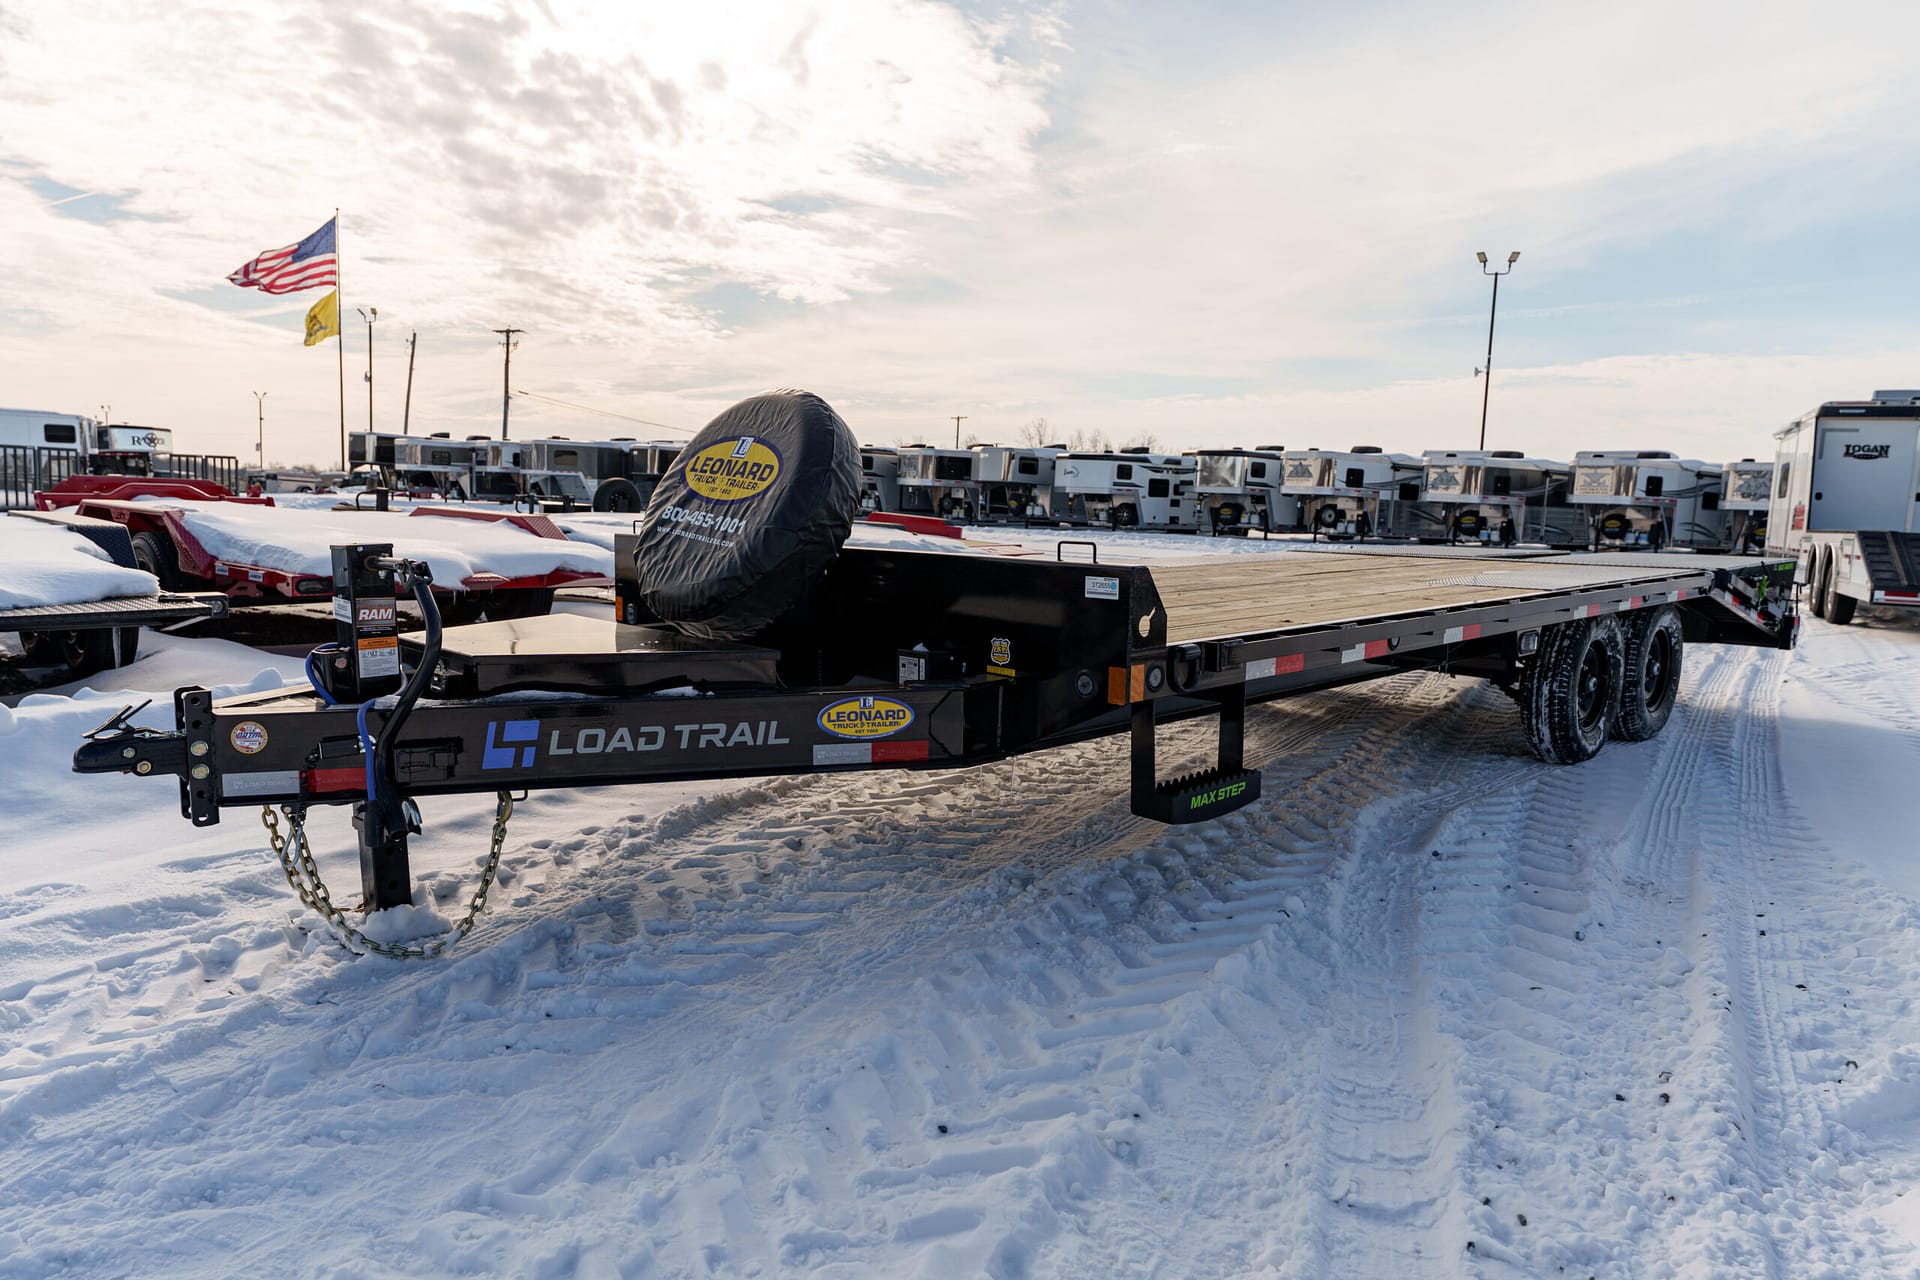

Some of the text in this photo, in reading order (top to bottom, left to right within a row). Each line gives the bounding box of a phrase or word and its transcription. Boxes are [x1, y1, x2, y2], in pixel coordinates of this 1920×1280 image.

[1843, 444, 1891, 458] LOGAN
[689, 456, 775, 482] LEONARD
[692, 474, 717, 485] TRUCK
[725, 477, 759, 491] TRAILER
[661, 505, 747, 535] 800-455-1001
[358, 608, 393, 620] RAM
[826, 709, 907, 723] LEONARD
[548, 725, 667, 755] LOAD
[674, 720, 790, 749] TRAIL
[1190, 781, 1247, 809] MAX STEP
